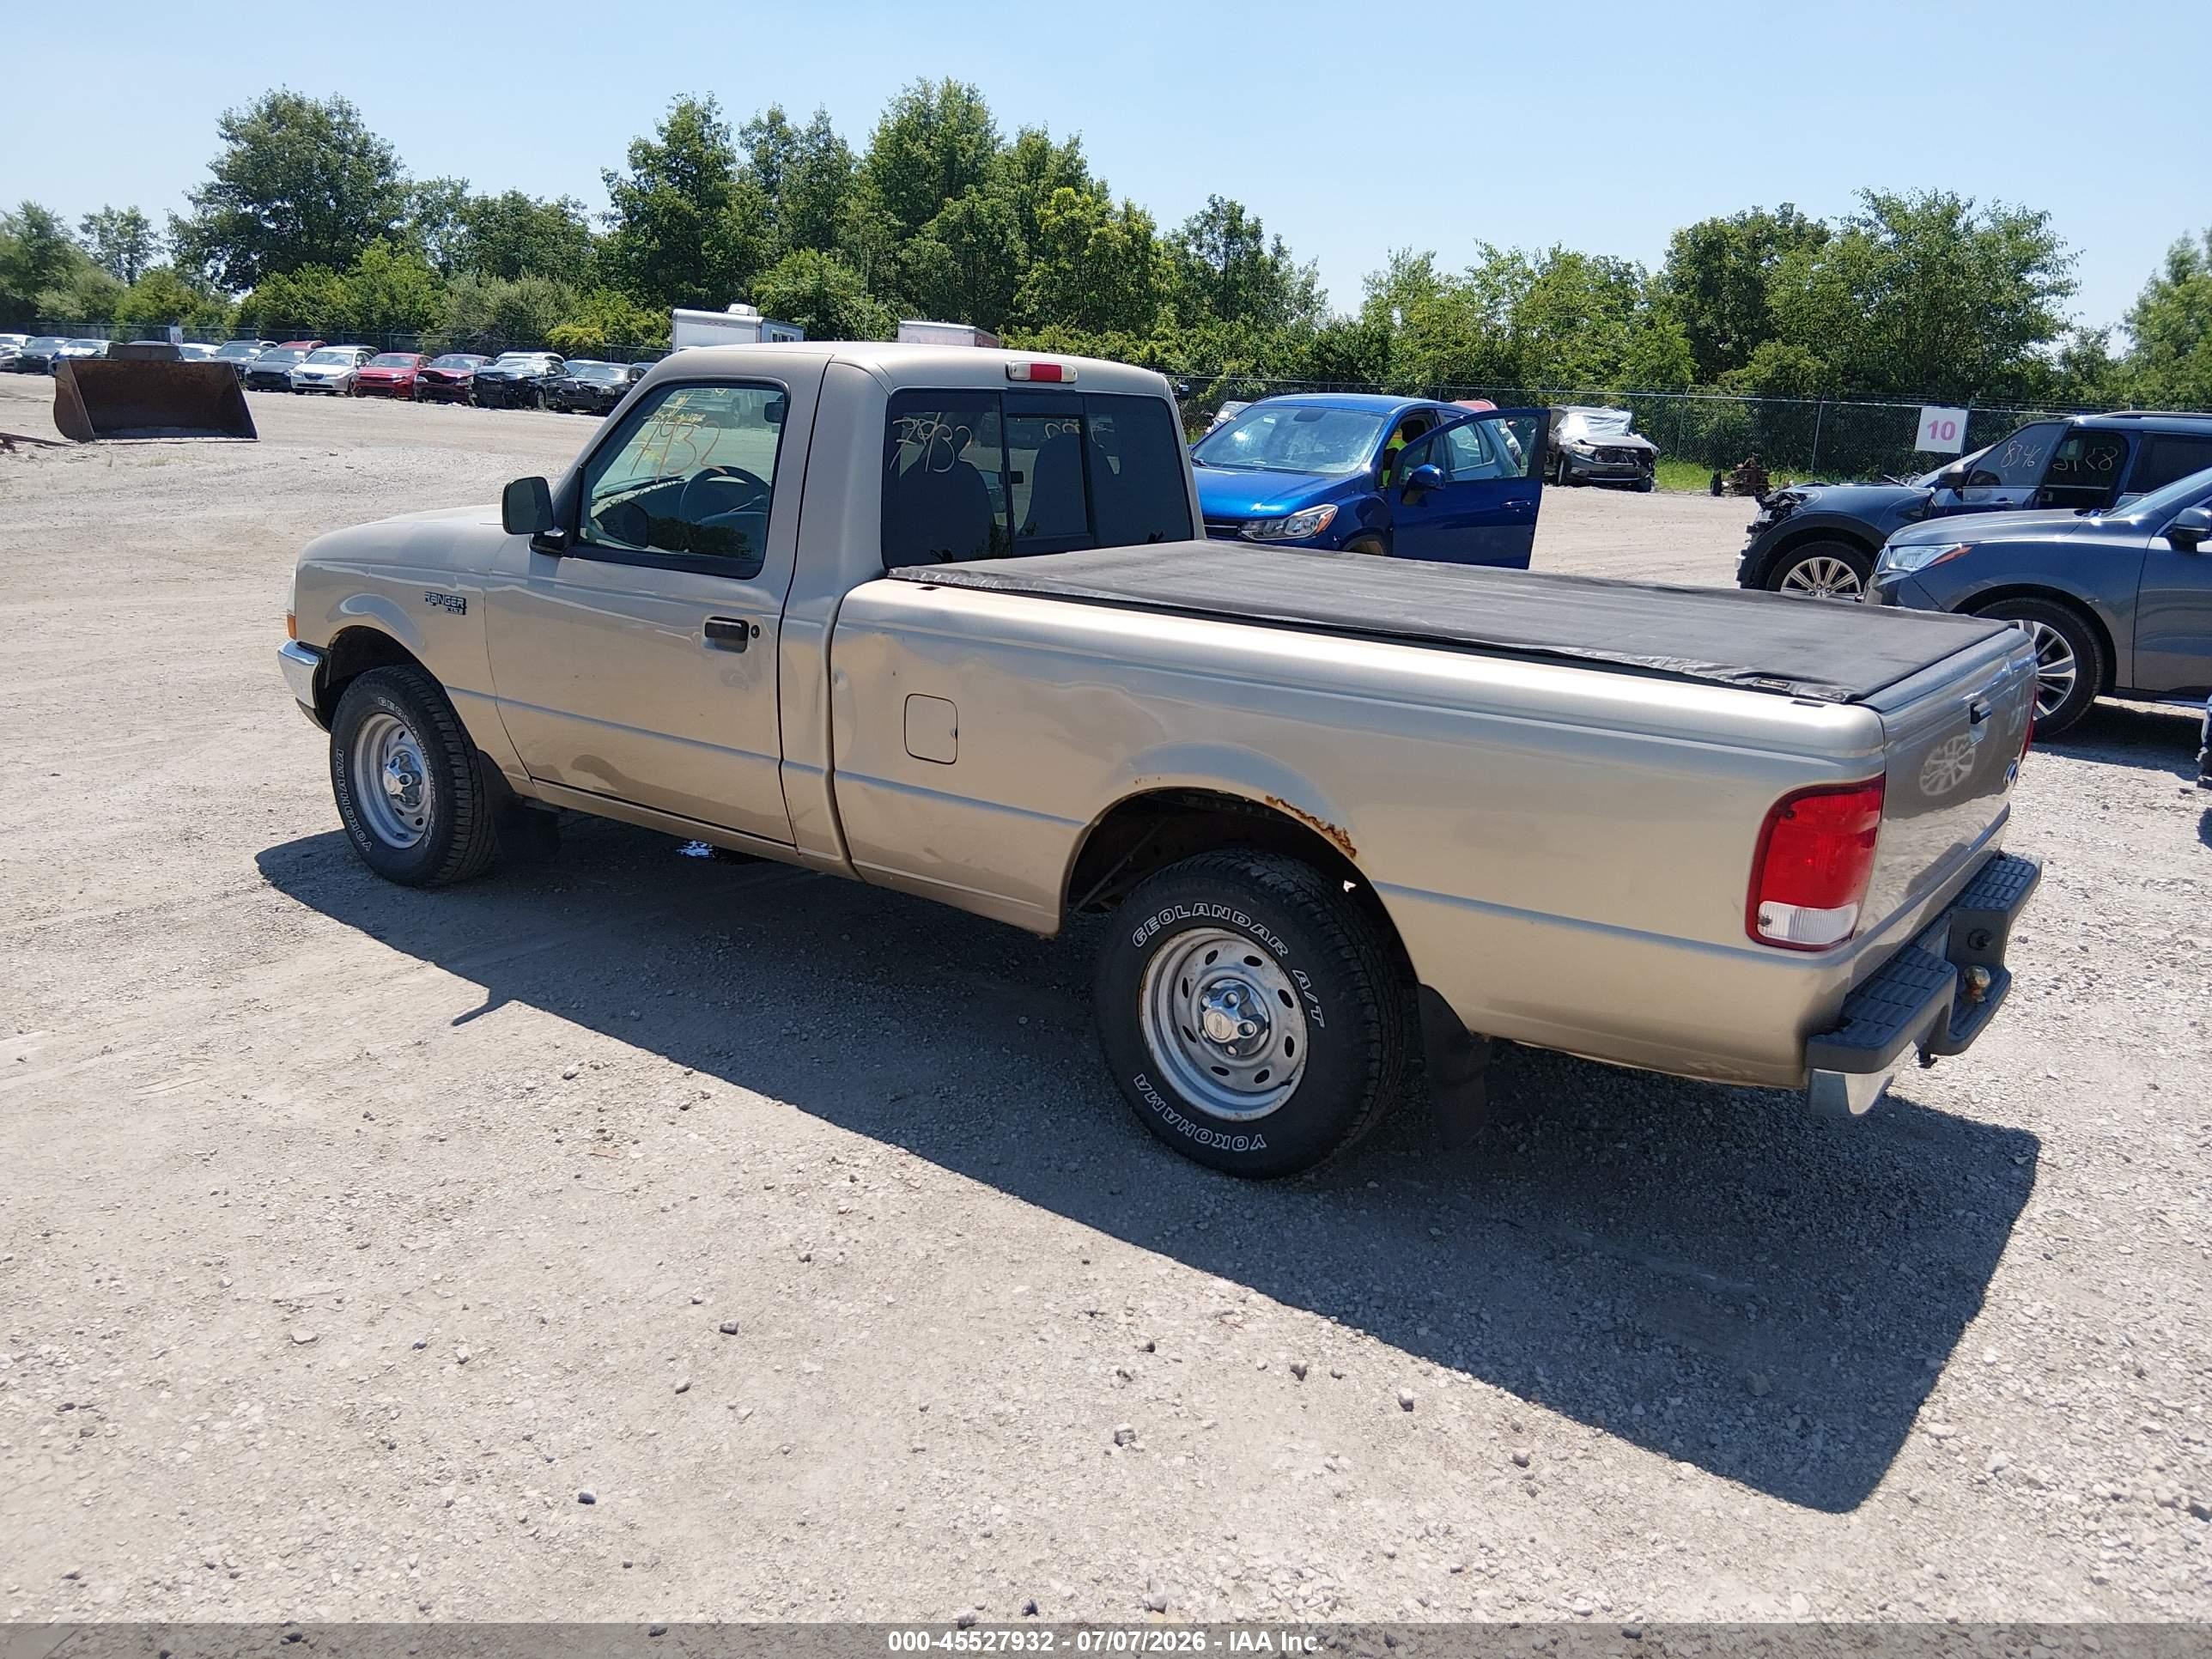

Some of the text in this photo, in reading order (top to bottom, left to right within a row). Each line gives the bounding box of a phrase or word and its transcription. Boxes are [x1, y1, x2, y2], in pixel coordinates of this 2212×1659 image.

[1927, 420, 1956, 441] 10
[424, 592, 465, 609] RANGER
[336, 748, 373, 852] YOKOHAMA
[1132, 902, 1325, 1029] GEOLANDAR A/T
[1133, 1073, 1267, 1152] YOKOHAMA
